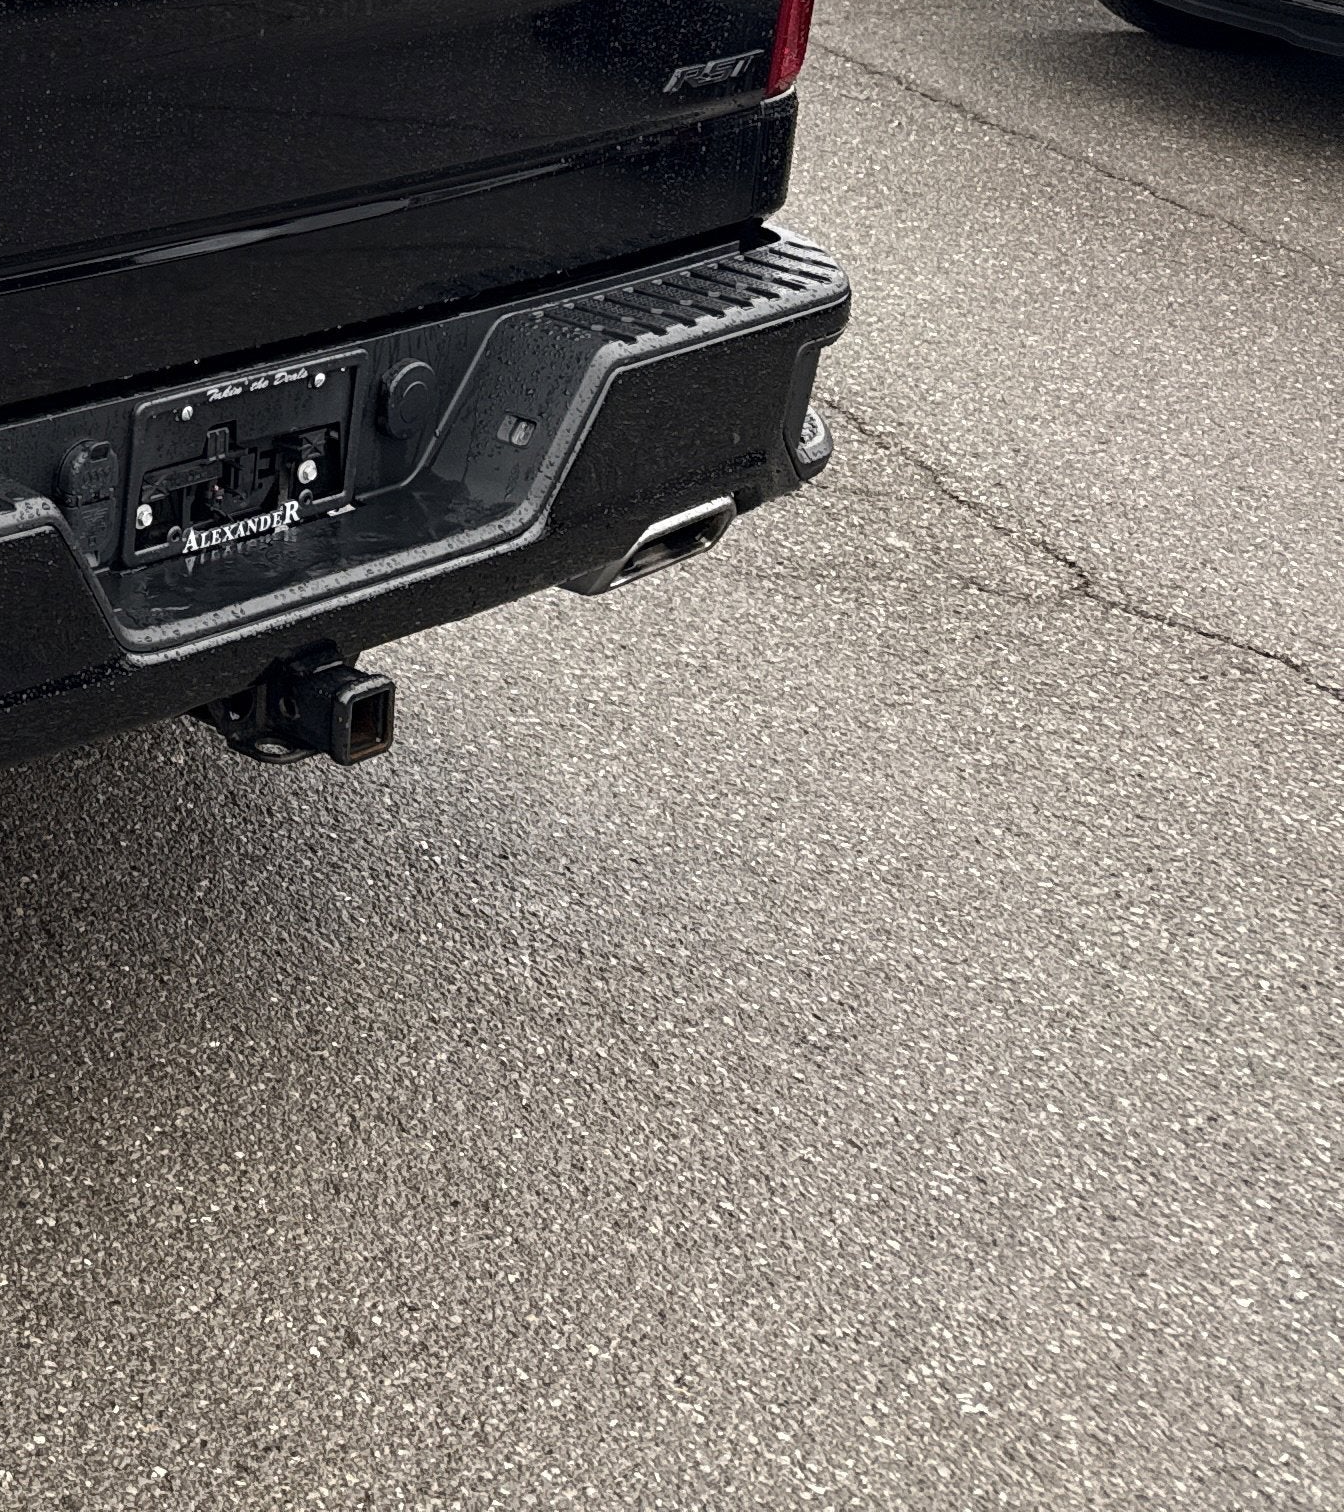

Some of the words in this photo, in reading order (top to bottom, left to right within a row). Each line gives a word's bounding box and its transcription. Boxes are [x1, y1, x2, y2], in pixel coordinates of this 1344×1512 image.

[662, 49, 765, 93] RST
[250, 377, 270, 392] the
[182, 500, 301, 554] ALEXANDER
